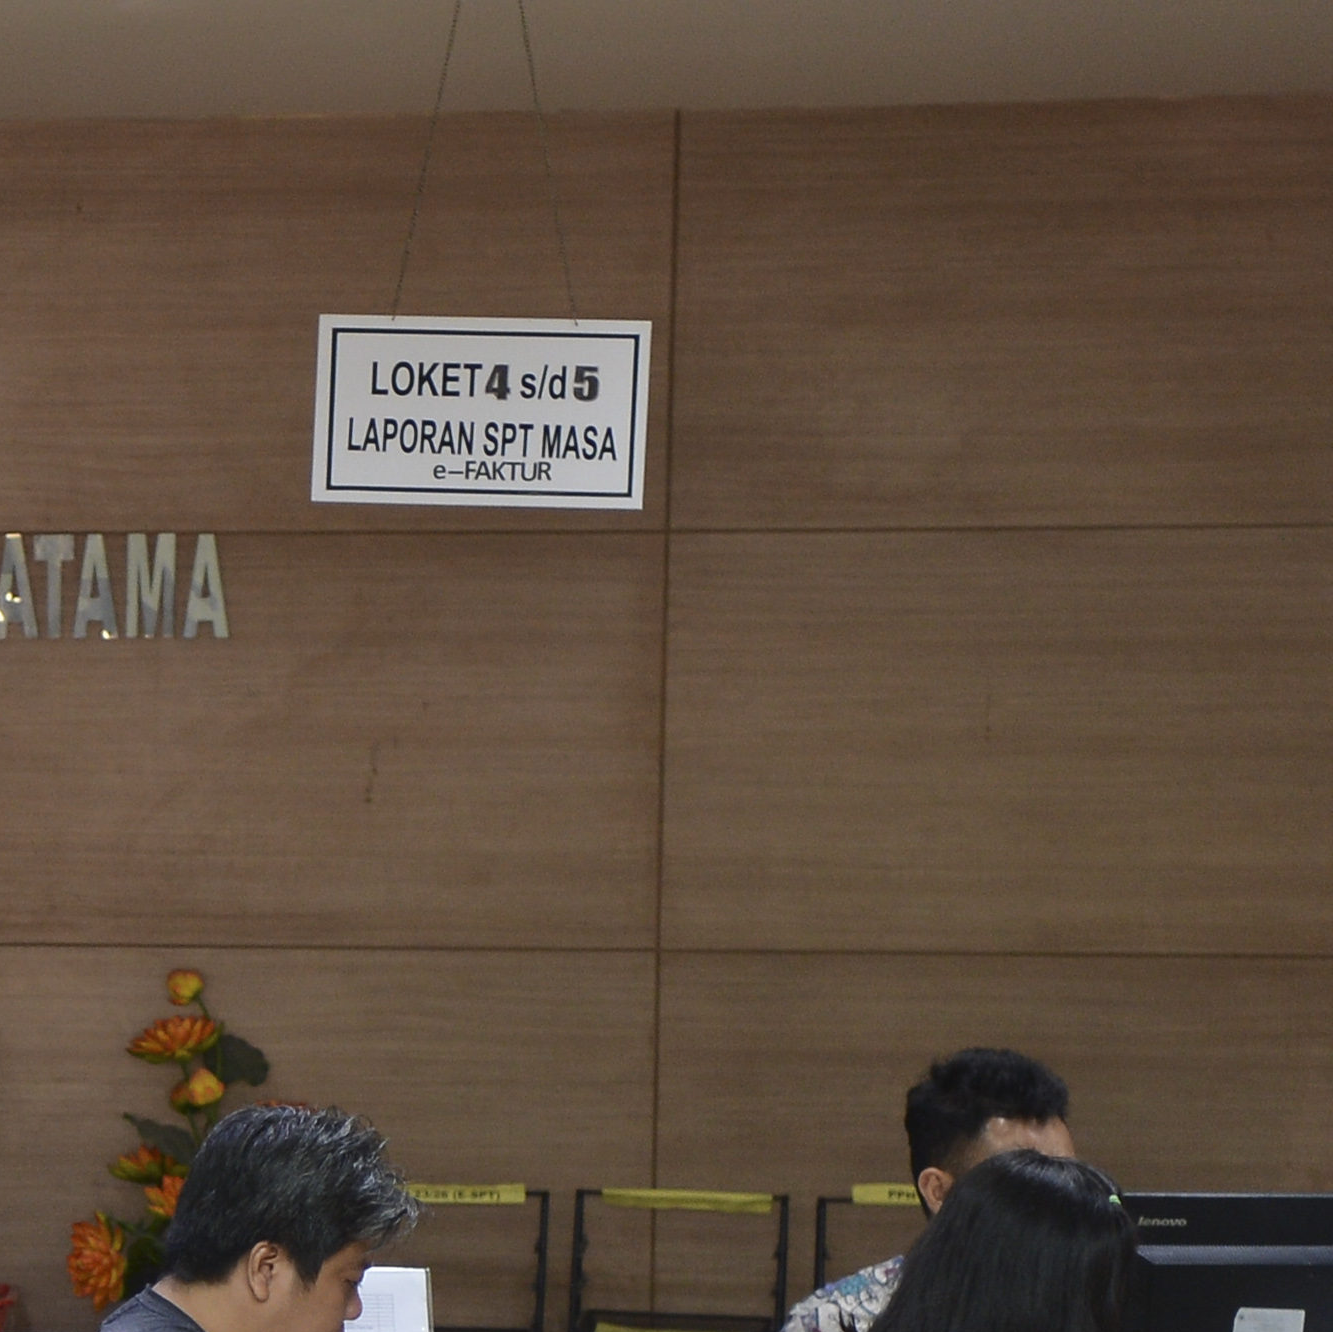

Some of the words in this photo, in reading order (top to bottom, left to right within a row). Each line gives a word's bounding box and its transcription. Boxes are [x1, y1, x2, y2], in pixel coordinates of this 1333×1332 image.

[371, 361, 483, 397] LOKET
[485, 364, 511, 400] 4
[520, 364, 567, 400] s/d
[573, 365, 600, 402] 5
[347, 417, 475, 455] LAPORAN
[483, 421, 534, 458] SPT
[541, 424, 617, 461] MASA
